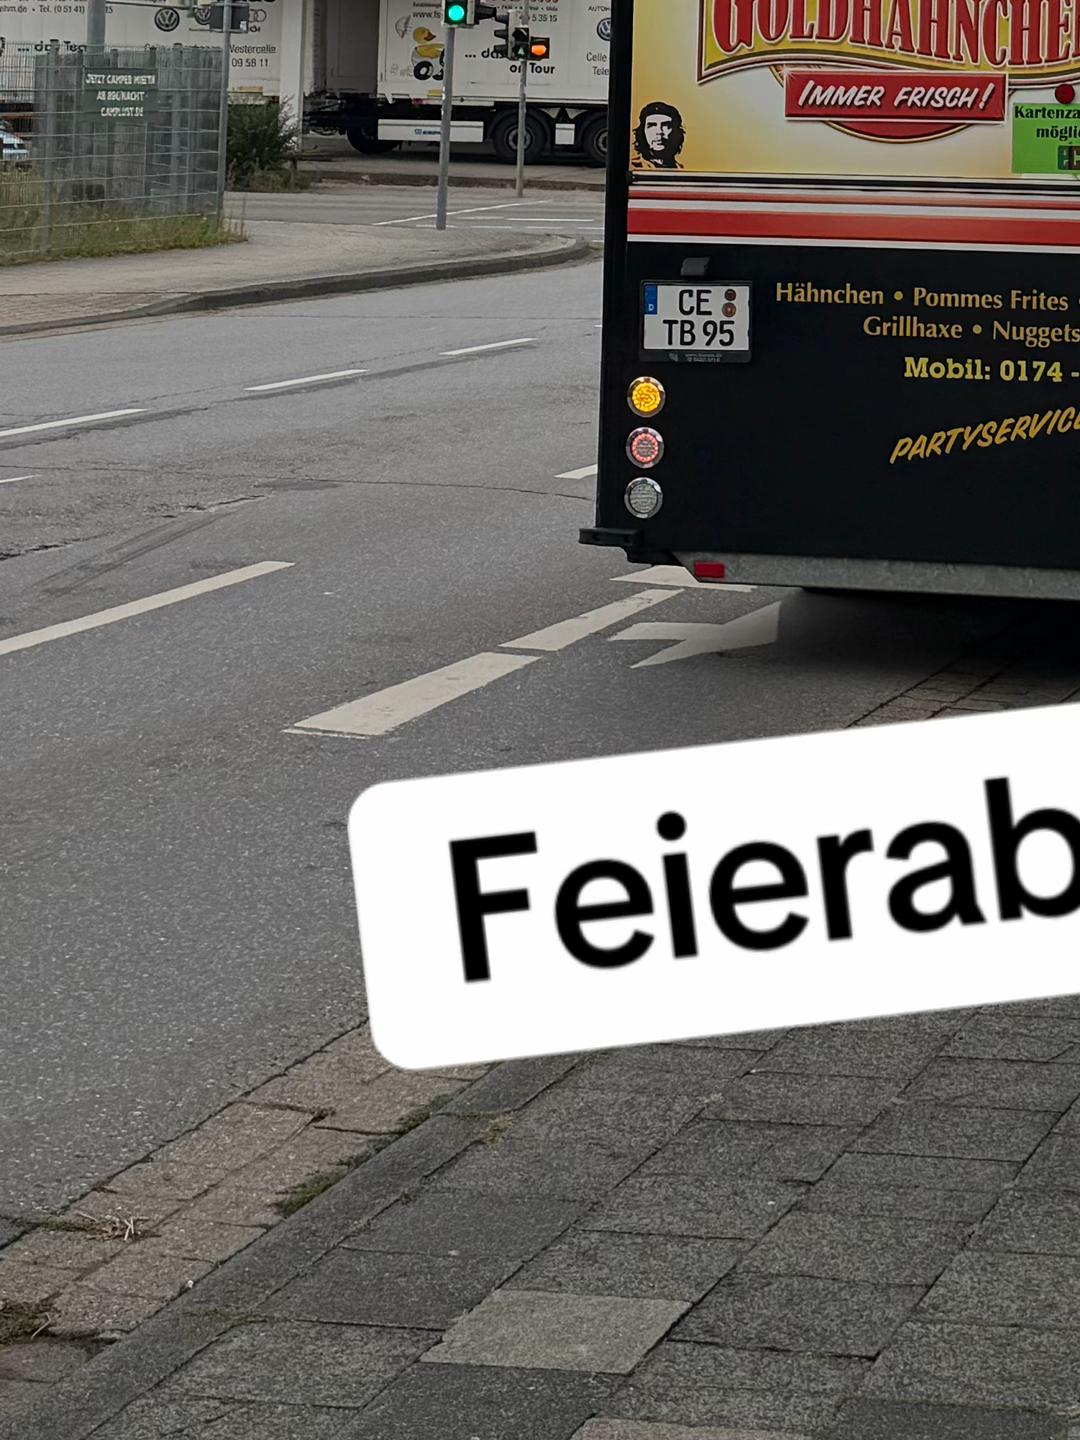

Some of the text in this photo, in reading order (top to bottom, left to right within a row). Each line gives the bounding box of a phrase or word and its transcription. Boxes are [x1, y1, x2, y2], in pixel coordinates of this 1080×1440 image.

[530, 62, 556, 74] Tour
[586, 52, 607, 62] Celle
[797, 79, 995, 110] IMMER FRISCH!
[678, 289, 713, 316] CE
[775, 282, 884, 305] Hähnchen
[913, 287, 1003, 309] Pommes
[1010, 289, 1069, 311] Frites
[662, 319, 735, 347] TB 95
[863, 315, 963, 339] Grillhaxe
[993, 320, 1080, 348] Nuggets
[904, 357, 991, 380] Mobil:
[1000, 359, 1063, 383] 0174
